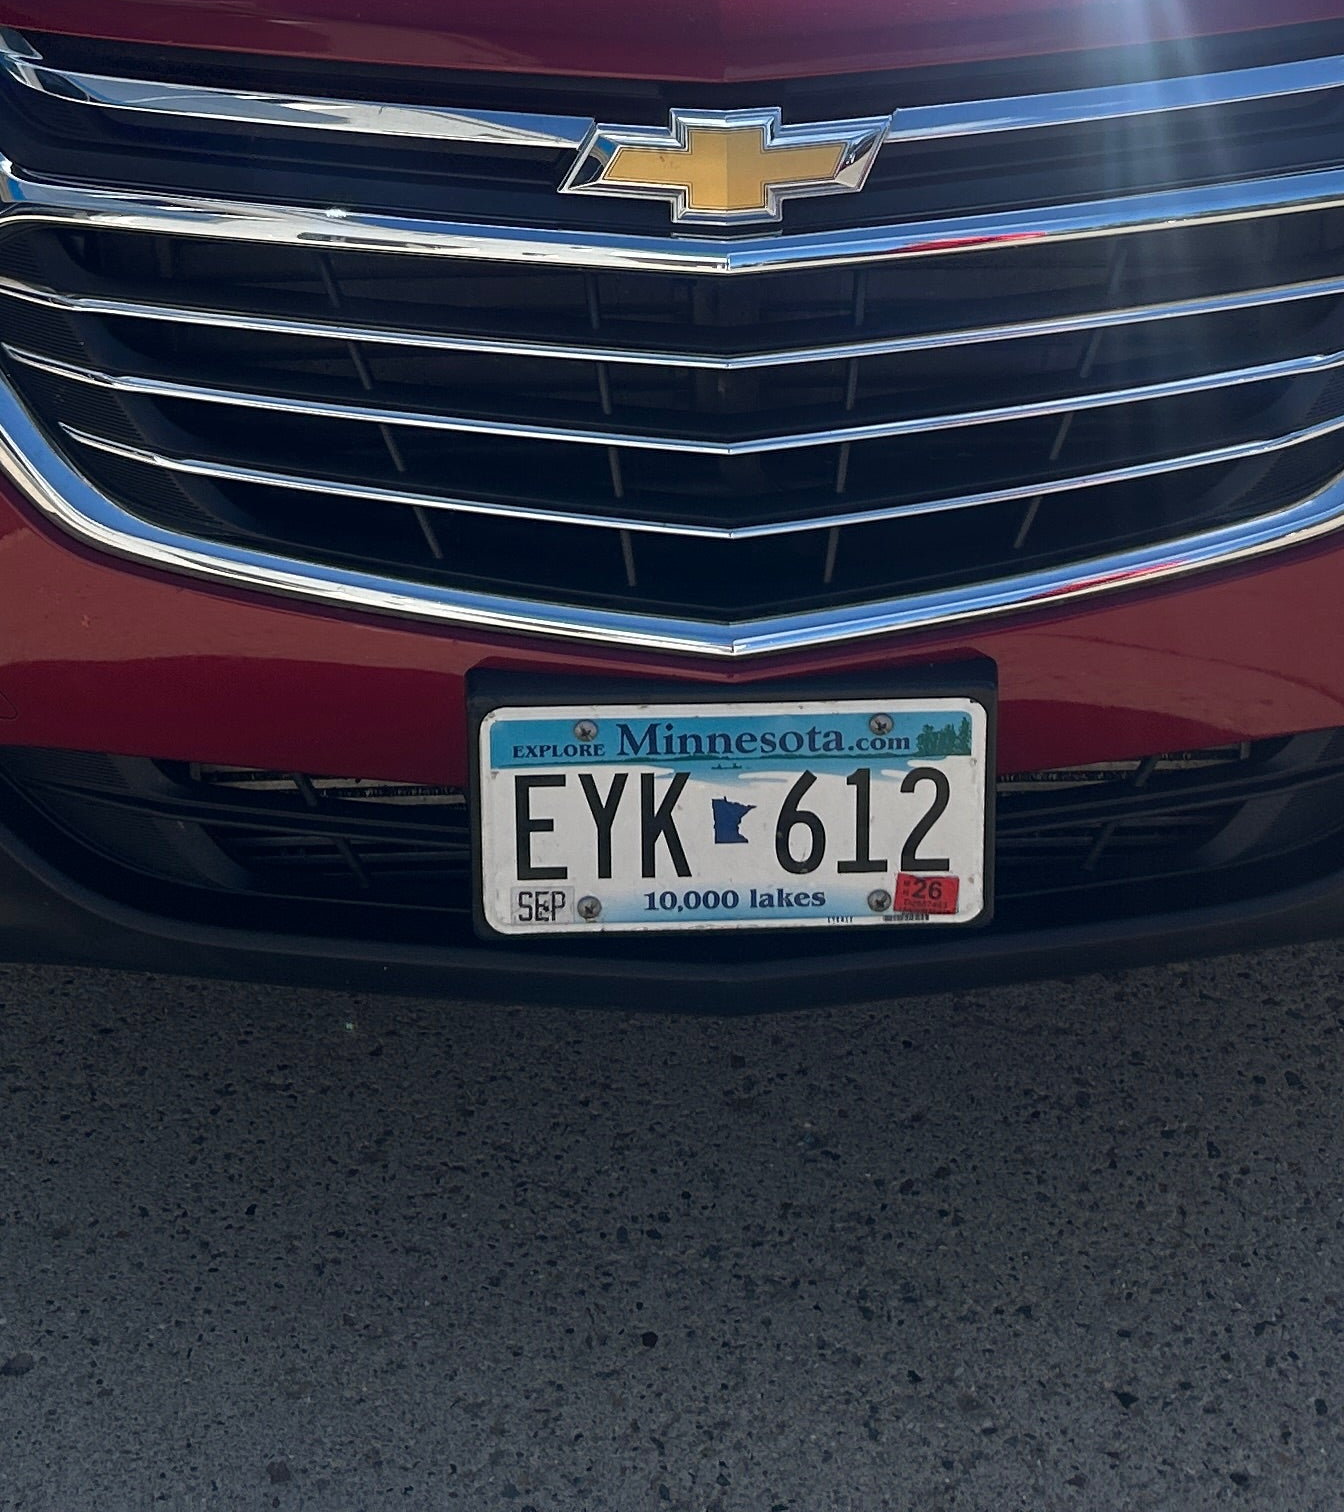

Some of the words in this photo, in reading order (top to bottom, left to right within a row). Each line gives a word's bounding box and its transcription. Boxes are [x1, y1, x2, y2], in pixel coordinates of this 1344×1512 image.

[513, 743, 605, 758] EXPLORE
[615, 722, 911, 756] Minnesota.com
[514, 771, 693, 881] EYK
[775, 766, 951, 875] 612
[644, 890, 740, 912] 10,000
[749, 888, 827, 908] lakes
[911, 879, 943, 901] 26
[518, 891, 567, 922] SEP
